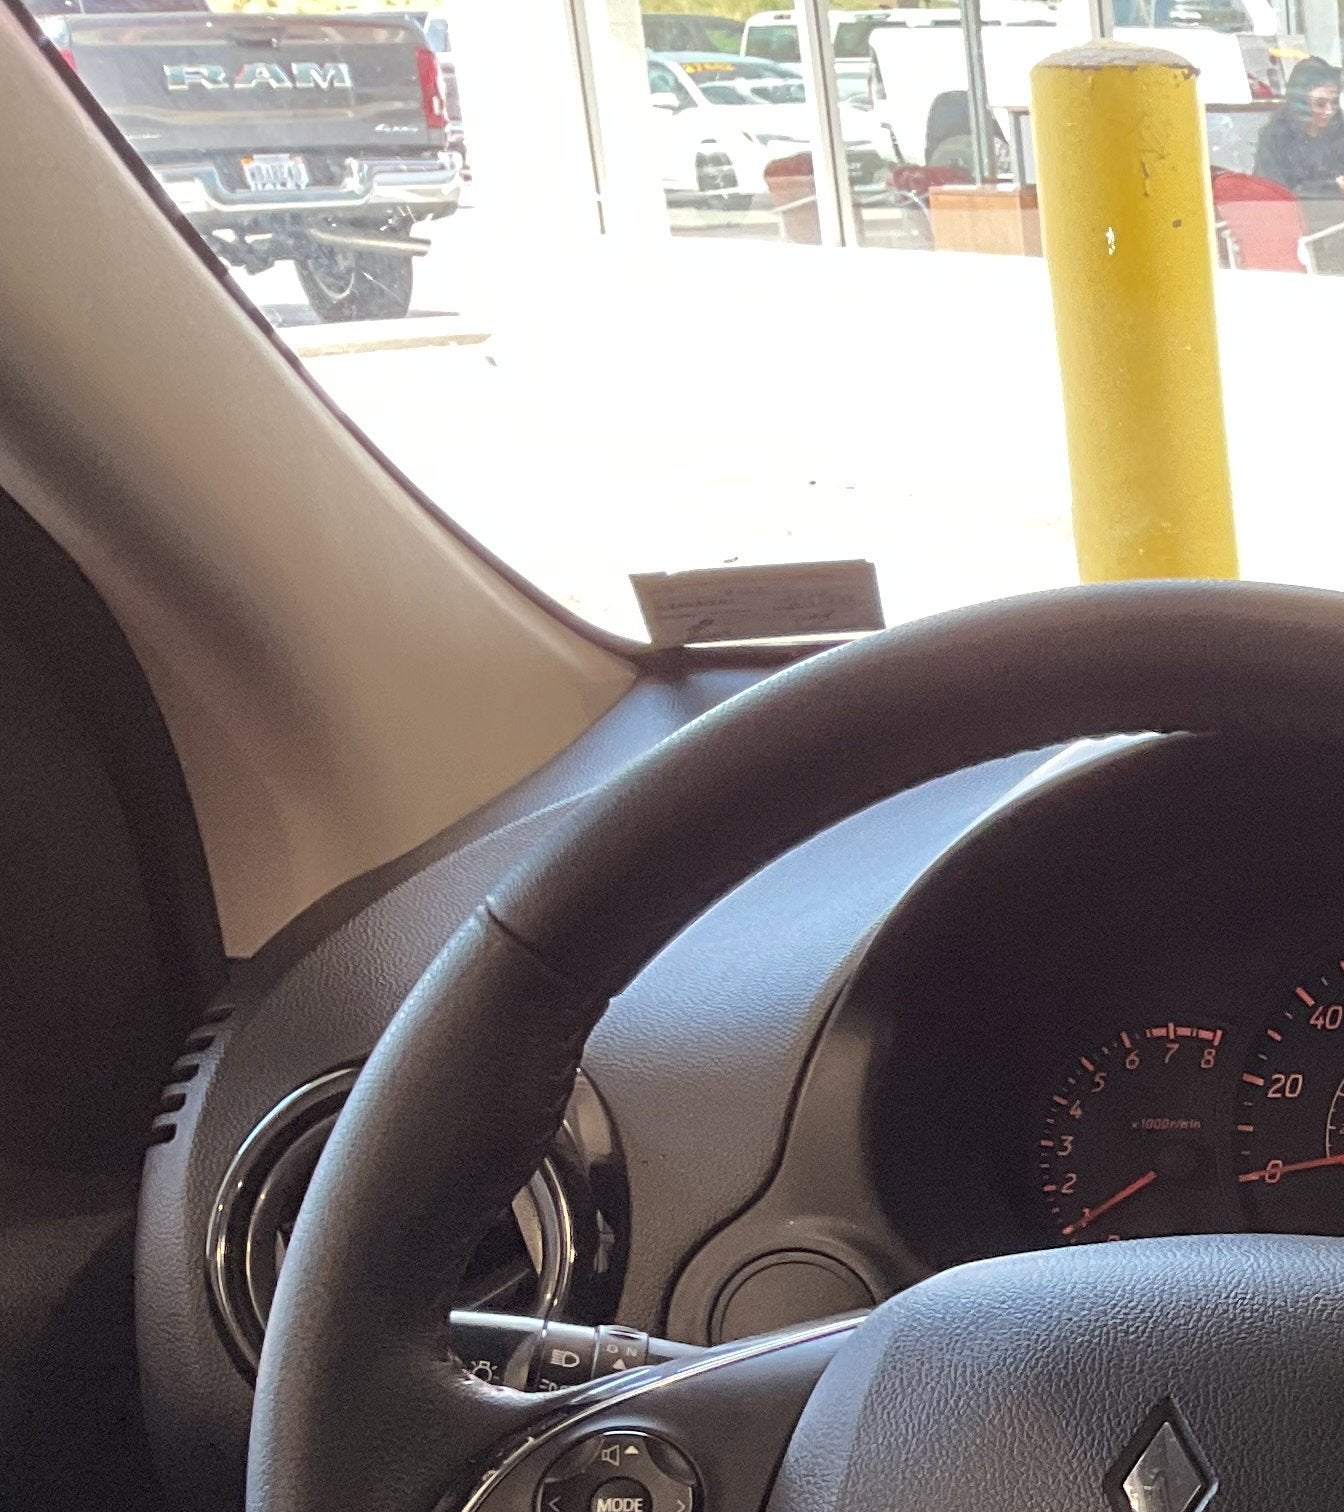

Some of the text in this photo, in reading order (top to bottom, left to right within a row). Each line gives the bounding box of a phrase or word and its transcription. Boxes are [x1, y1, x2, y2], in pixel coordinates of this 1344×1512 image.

[163, 62, 353, 90] RAM
[1309, 1005, 1343, 1030] 40
[1125, 1050, 1140, 1069] 6
[1164, 1043, 1180, 1064] 7
[1200, 1049, 1216, 1069] 8
[1091, 1071, 1107, 1093] 5
[1266, 1073, 1304, 1099] 20
[1069, 1099, 1083, 1119] 4
[1056, 1135, 1074, 1157] 3
[1061, 1172, 1077, 1195] 2
[596, 1497, 643, 1512] MODE
